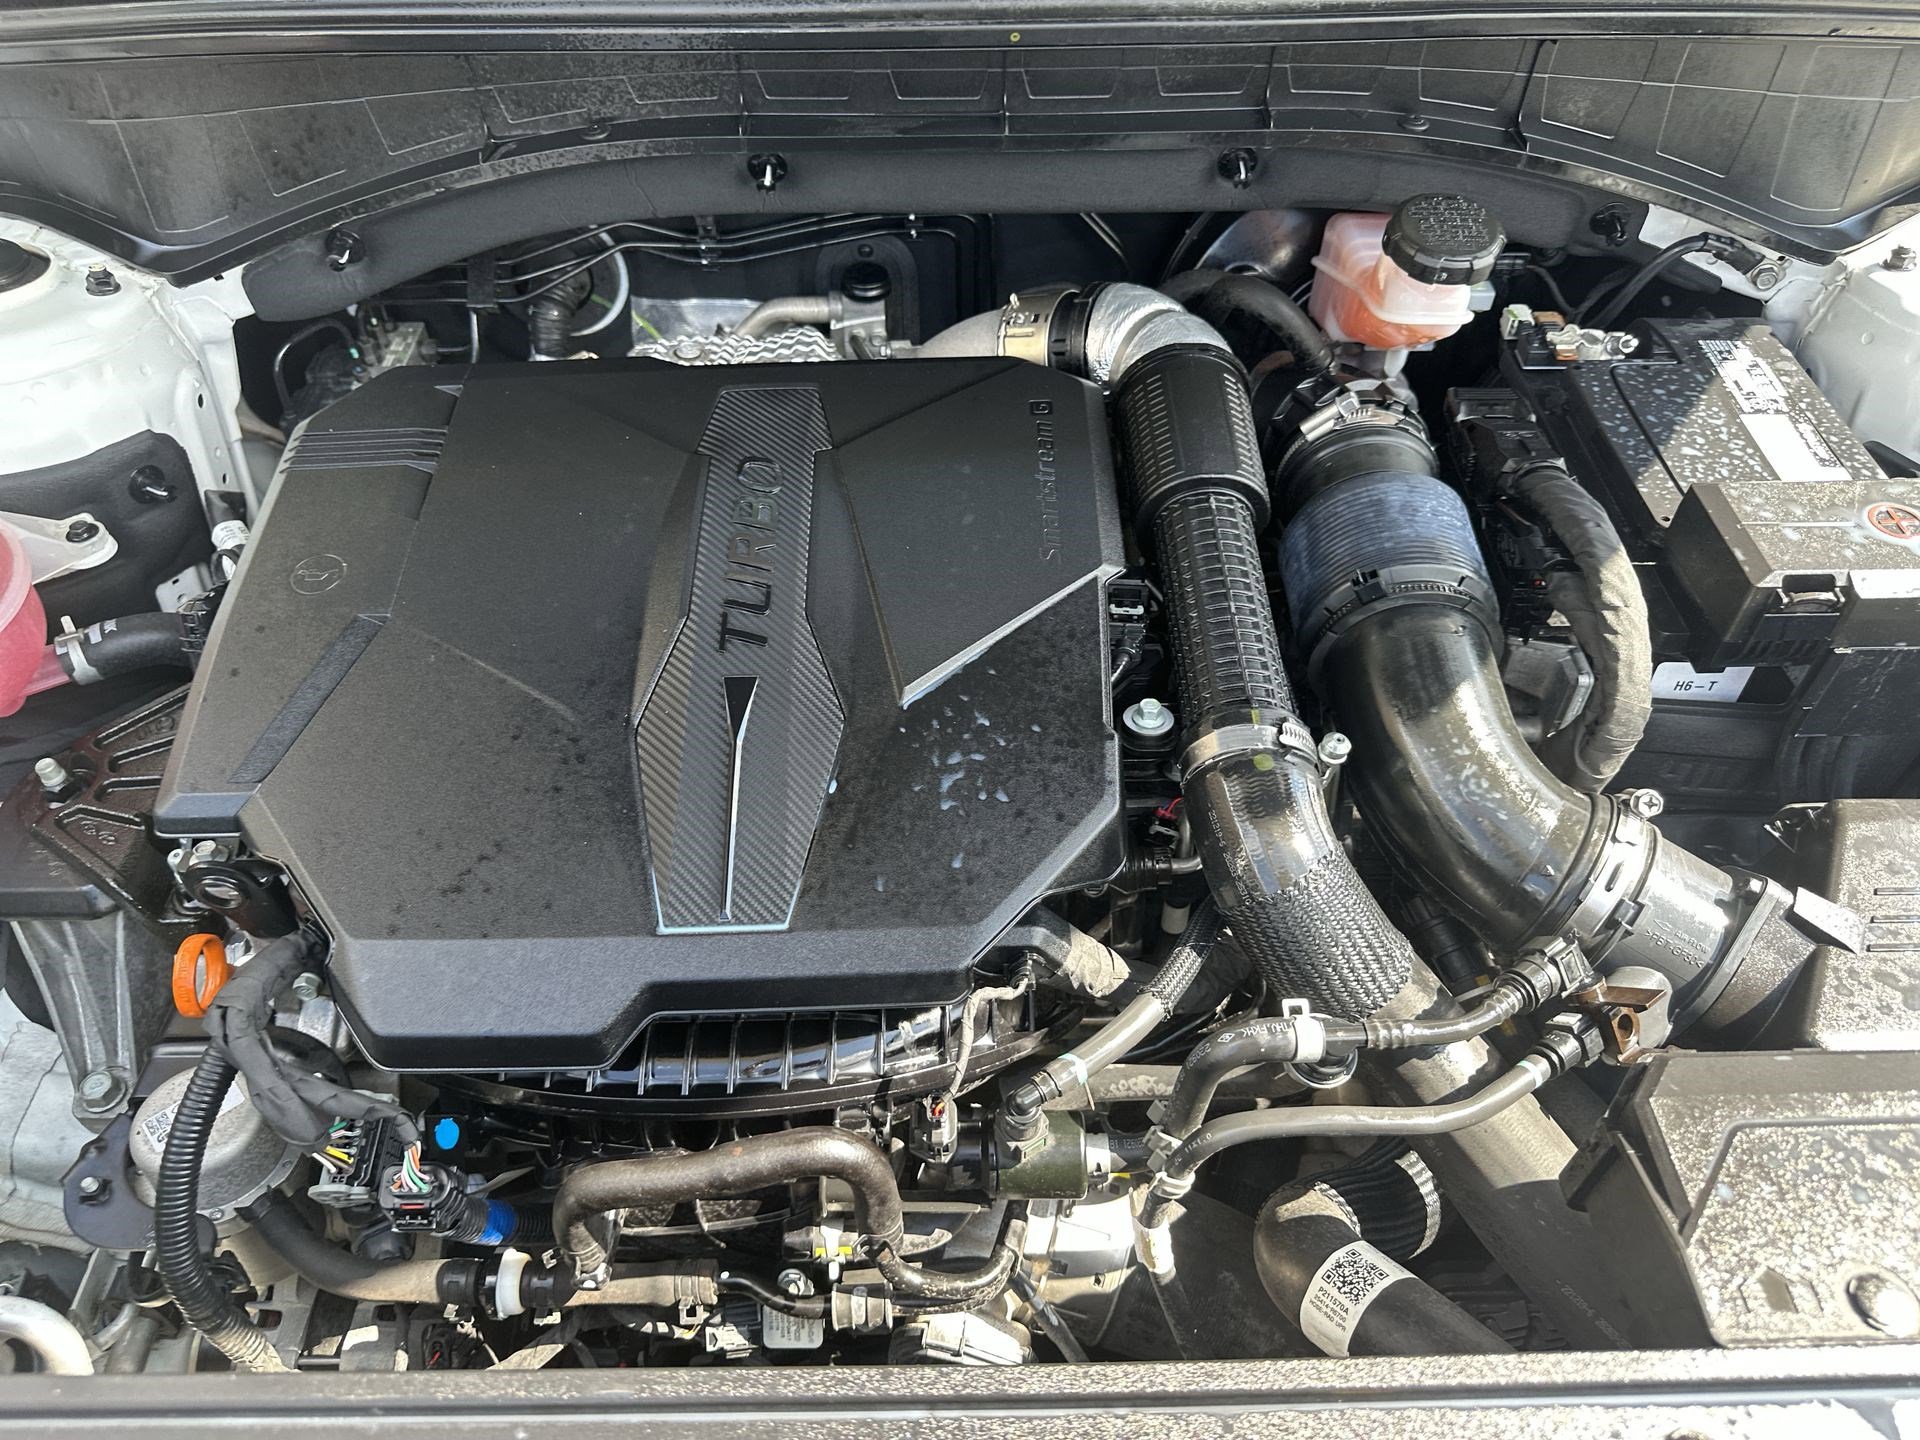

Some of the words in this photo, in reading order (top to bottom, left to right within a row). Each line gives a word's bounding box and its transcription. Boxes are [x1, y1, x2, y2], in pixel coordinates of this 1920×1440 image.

[717, 456, 783, 654] TURBO
[1035, 420, 1062, 564] Smartstream
[1318, 1286, 1350, 1315] P211570A
